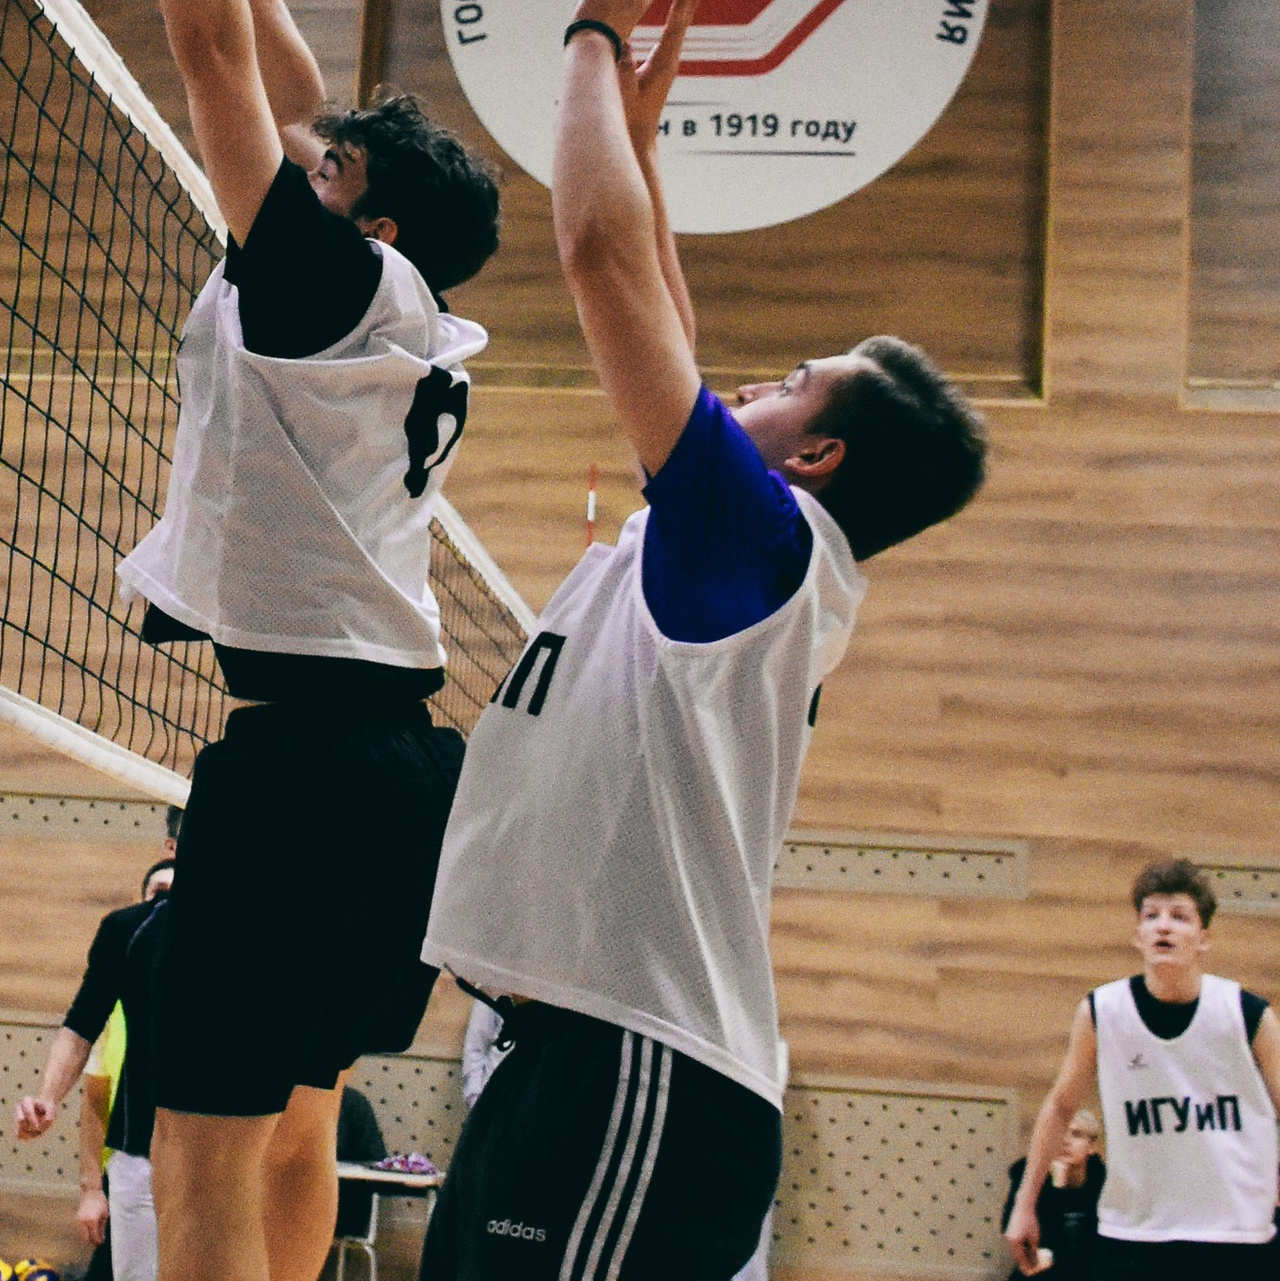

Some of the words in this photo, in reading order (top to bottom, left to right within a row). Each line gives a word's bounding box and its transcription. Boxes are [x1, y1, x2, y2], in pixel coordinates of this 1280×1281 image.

[682, 119, 697, 137] в
[710, 113, 779, 138] 1919
[790, 119, 857, 144] году
[1123, 1095, 1243, 1137] ИГУиП
[486, 1218, 548, 1243] adidas
